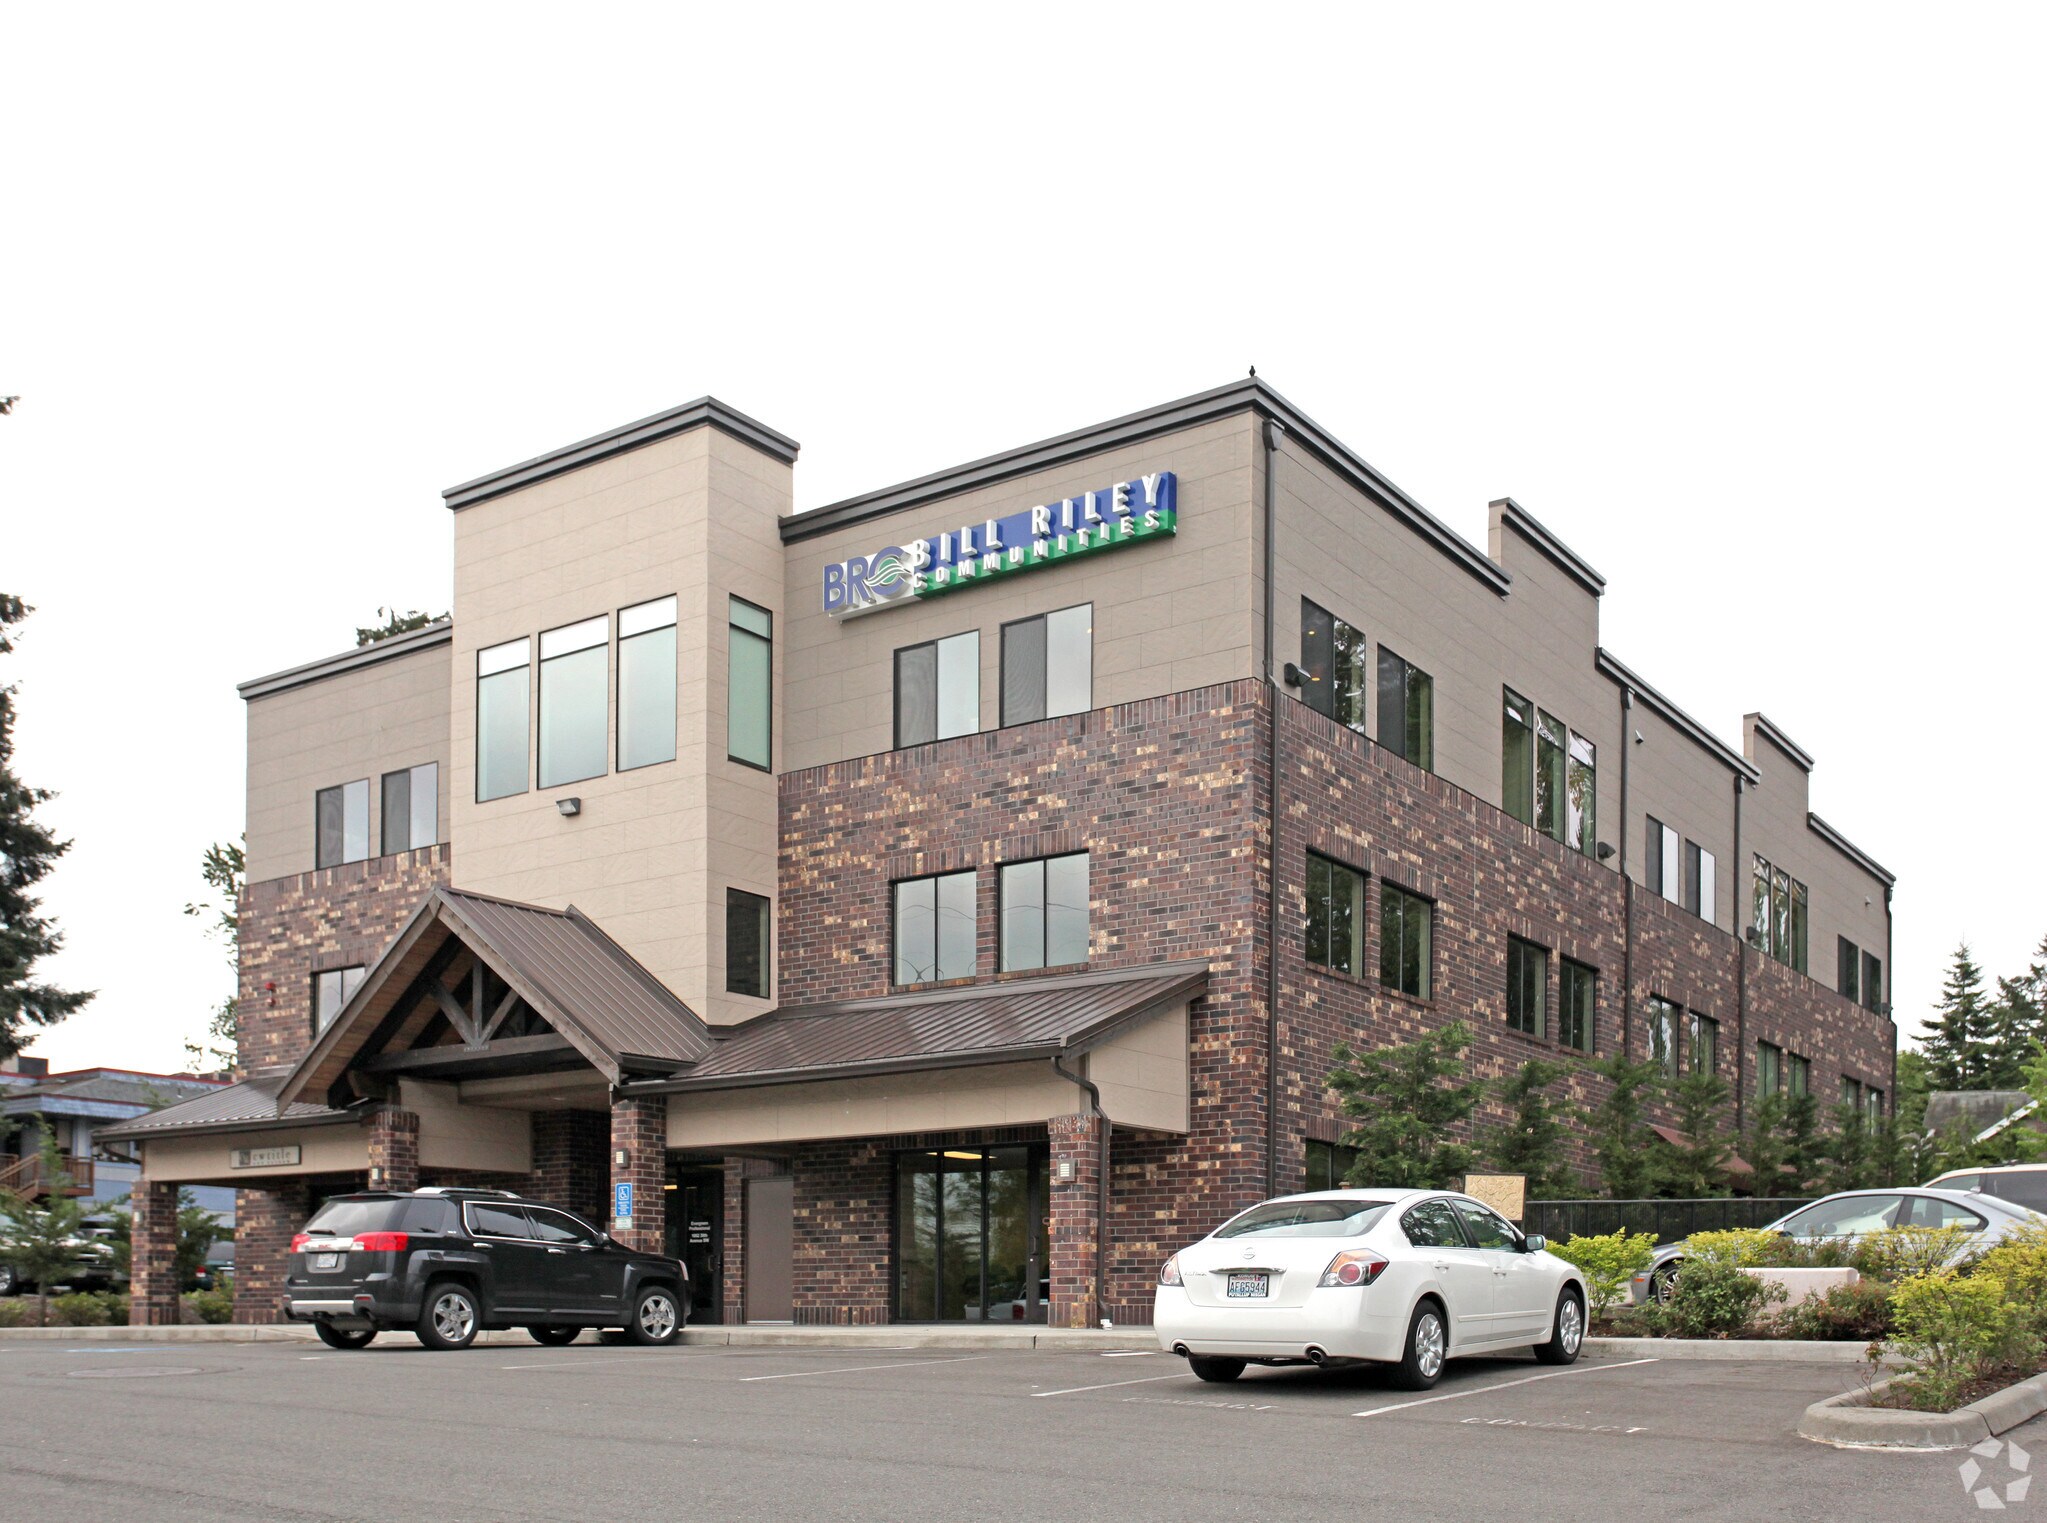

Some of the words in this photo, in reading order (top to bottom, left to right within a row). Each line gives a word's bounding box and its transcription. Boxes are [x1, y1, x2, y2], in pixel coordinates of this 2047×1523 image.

[912, 518, 1003, 569] BILL
[1031, 473, 1161, 537] RILEY
[913, 509, 1160, 592] COMMUNITIES
